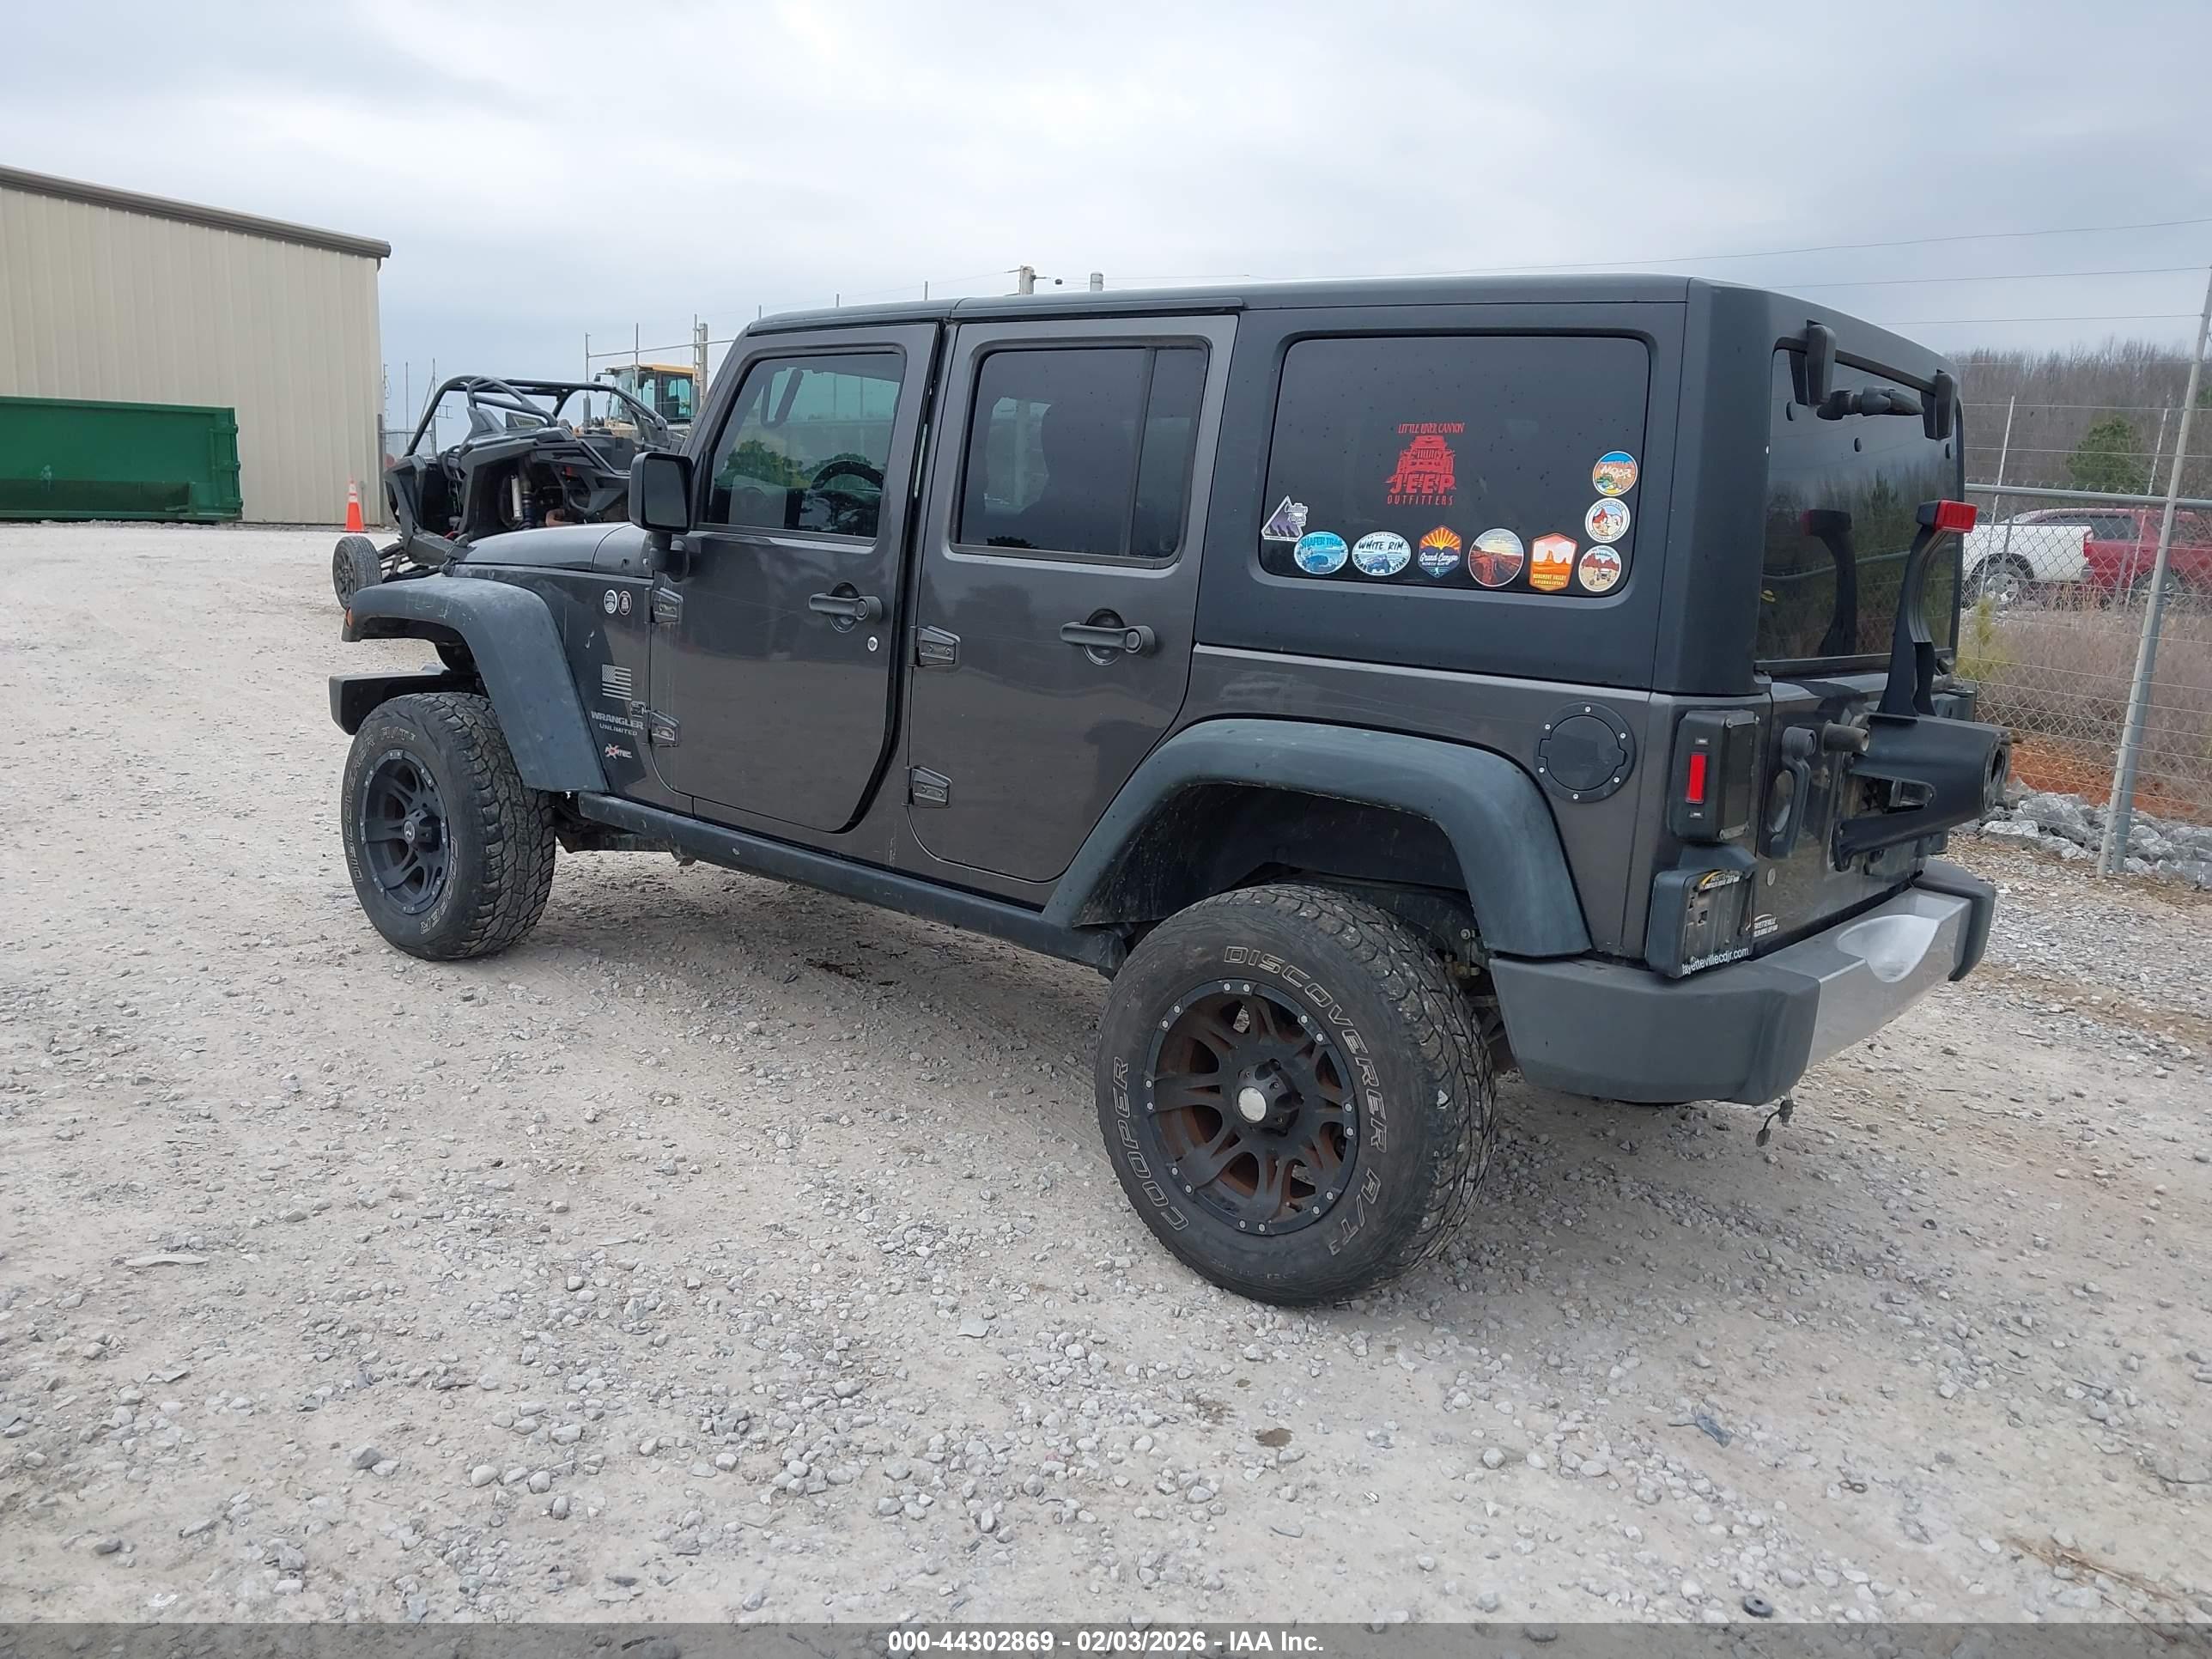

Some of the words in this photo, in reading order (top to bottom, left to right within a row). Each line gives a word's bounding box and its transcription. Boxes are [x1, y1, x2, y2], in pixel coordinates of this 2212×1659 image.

[1437, 422, 1465, 433] CANYON
[1389, 473, 1455, 493] JEEP
[1387, 495, 1453, 505] OUTFITTERS
[1358, 540, 1383, 550] WHITE
[1388, 541, 1404, 550] RIM
[591, 710, 644, 730] WRANGLER
[599, 722, 638, 737] UNLIMITED
[420, 836, 460, 934] COOPER
[1681, 946, 1749, 975] fayettevillecdjr.com
[1223, 945, 1389, 1154] DISCOVERER
[1113, 1056, 1188, 1231] COOPER
